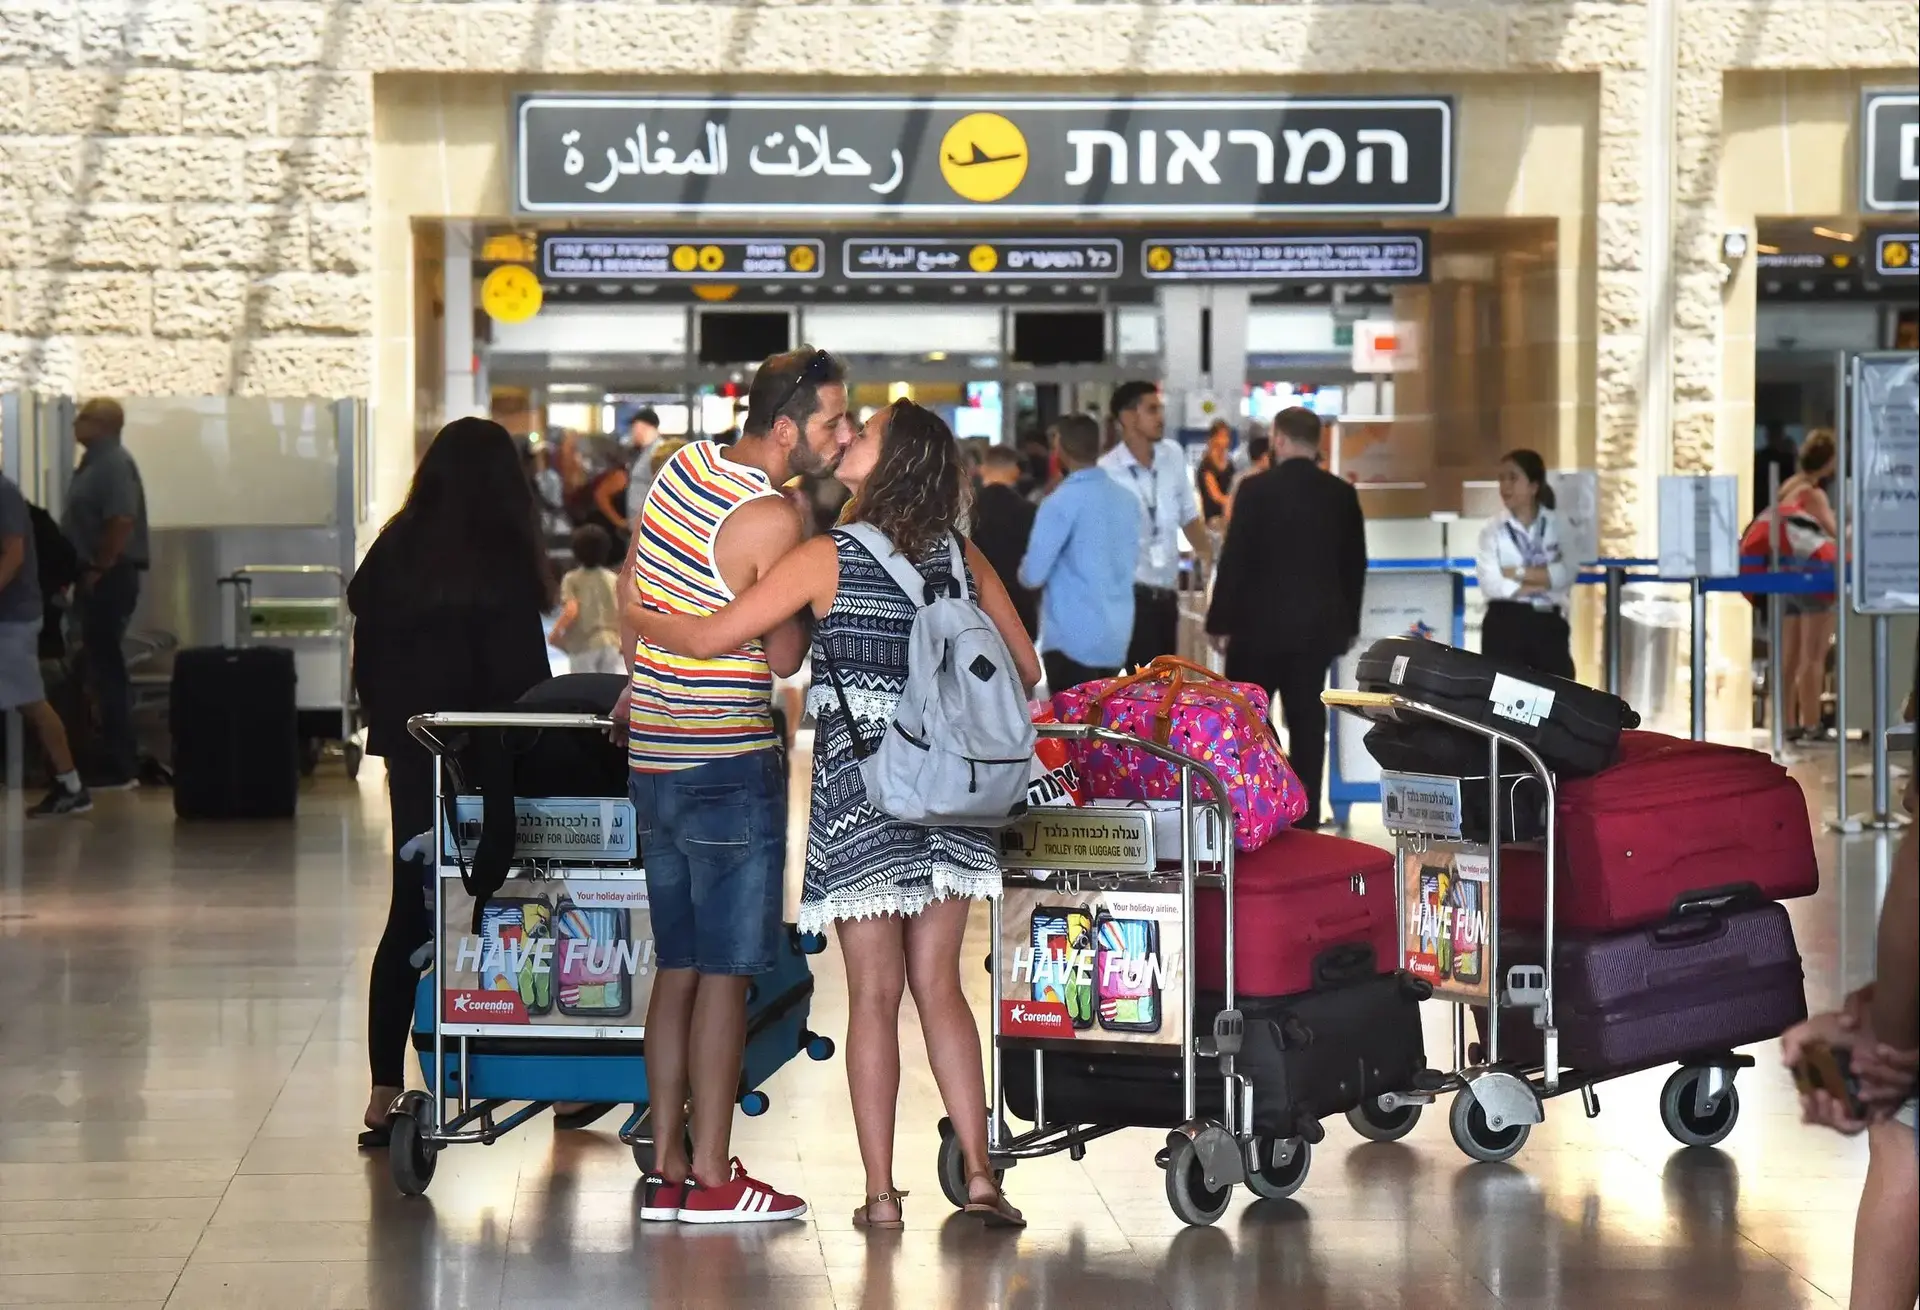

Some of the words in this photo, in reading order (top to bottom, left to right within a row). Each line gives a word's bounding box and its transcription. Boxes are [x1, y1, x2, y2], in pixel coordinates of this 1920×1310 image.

[561, 120, 729, 194] المغادرة
[749, 123, 904, 195] رحلات
[1064, 127, 1410, 186] המראות
[1007, 250, 1084, 269] השערים
[1086, 247, 1112, 267] כל
[519, 812, 542, 828] בלב
[545, 813, 589, 828] לכבודה
[592, 814, 623, 829] עה
[1043, 823, 1069, 838] בלבד
[1071, 824, 1109, 839] לכבודה
[1112, 824, 1140, 840] עגלה
[516, 833, 544, 844] ROLLEY
[547, 833, 565, 844] FOR
[565, 833, 601, 845] LUGGAGE
[606, 834, 624, 845] NLY
[1044, 843, 1072, 855] TROLLEY
[1074, 845, 1087, 856] FOR
[1089, 845, 1121, 857] LUGGAGE
[1123, 846, 1142, 858] ONLY
[576, 891, 595, 901] Your
[596, 891, 625, 903] holiday
[1113, 902, 1128, 911] Your
[1129, 902, 1155, 915] holiday
[1155, 904, 1180, 914] airline.
[1409, 901, 1453, 941] HAVE
[455, 935, 556, 974] HAVE
[562, 937, 654, 977] FUN!
[1011, 946, 1097, 987] HAVE
[468, 999, 514, 1011] corendon
[1022, 1011, 1062, 1023] corendon
